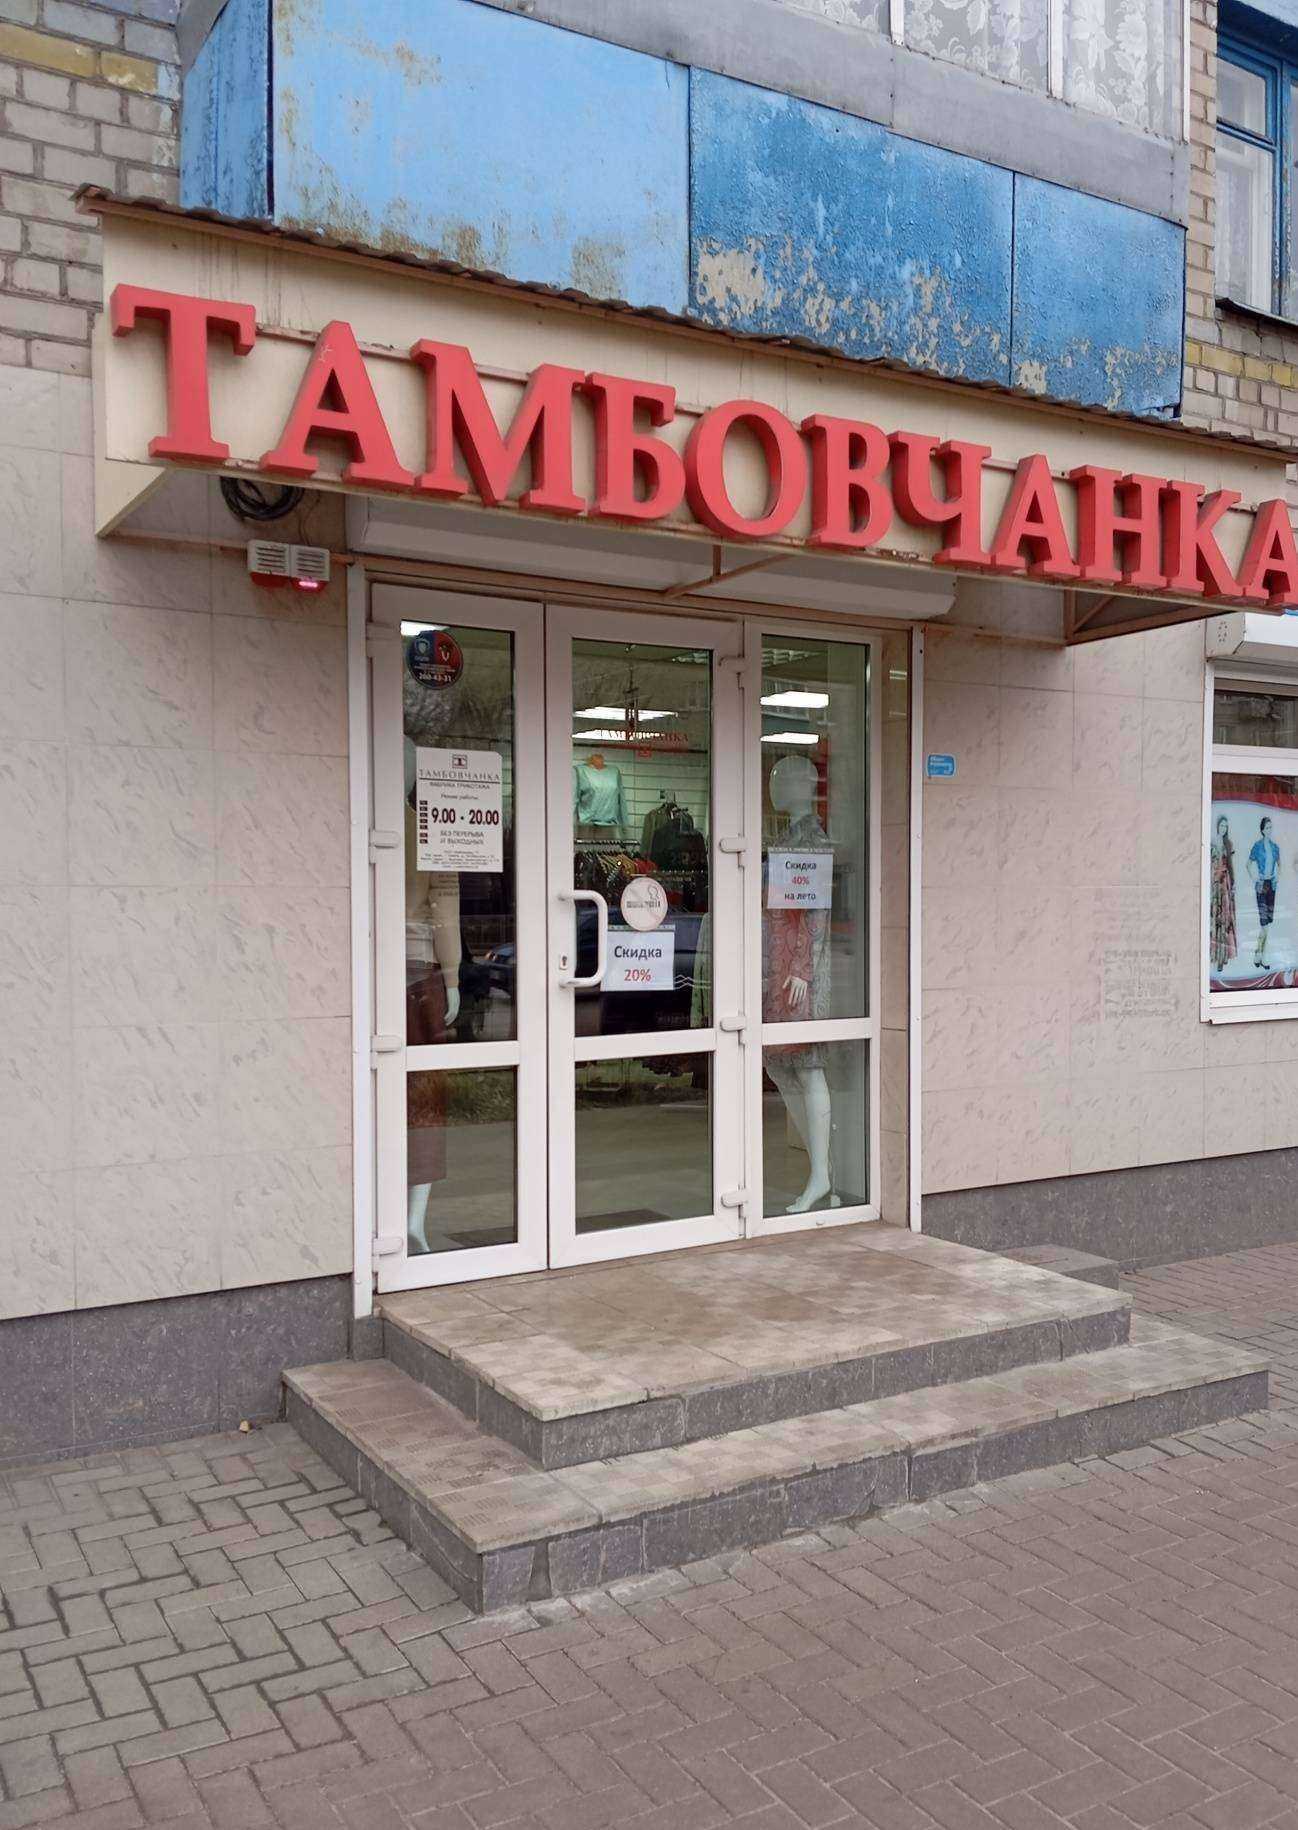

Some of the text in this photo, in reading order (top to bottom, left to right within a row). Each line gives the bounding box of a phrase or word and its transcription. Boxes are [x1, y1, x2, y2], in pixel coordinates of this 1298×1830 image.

[110, 283, 1298, 608] ТАМБОВЧАНКА
[419, 769, 500, 780] ТАМБОВЧАНКА
[431, 807, 456, 824] 9.00
[469, 809, 499, 825] 20.00
[785, 861, 817, 871] Скидка
[792, 876, 810, 885] 40%
[614, 945, 662, 960] Скидка
[624, 968, 652, 982] 20%
